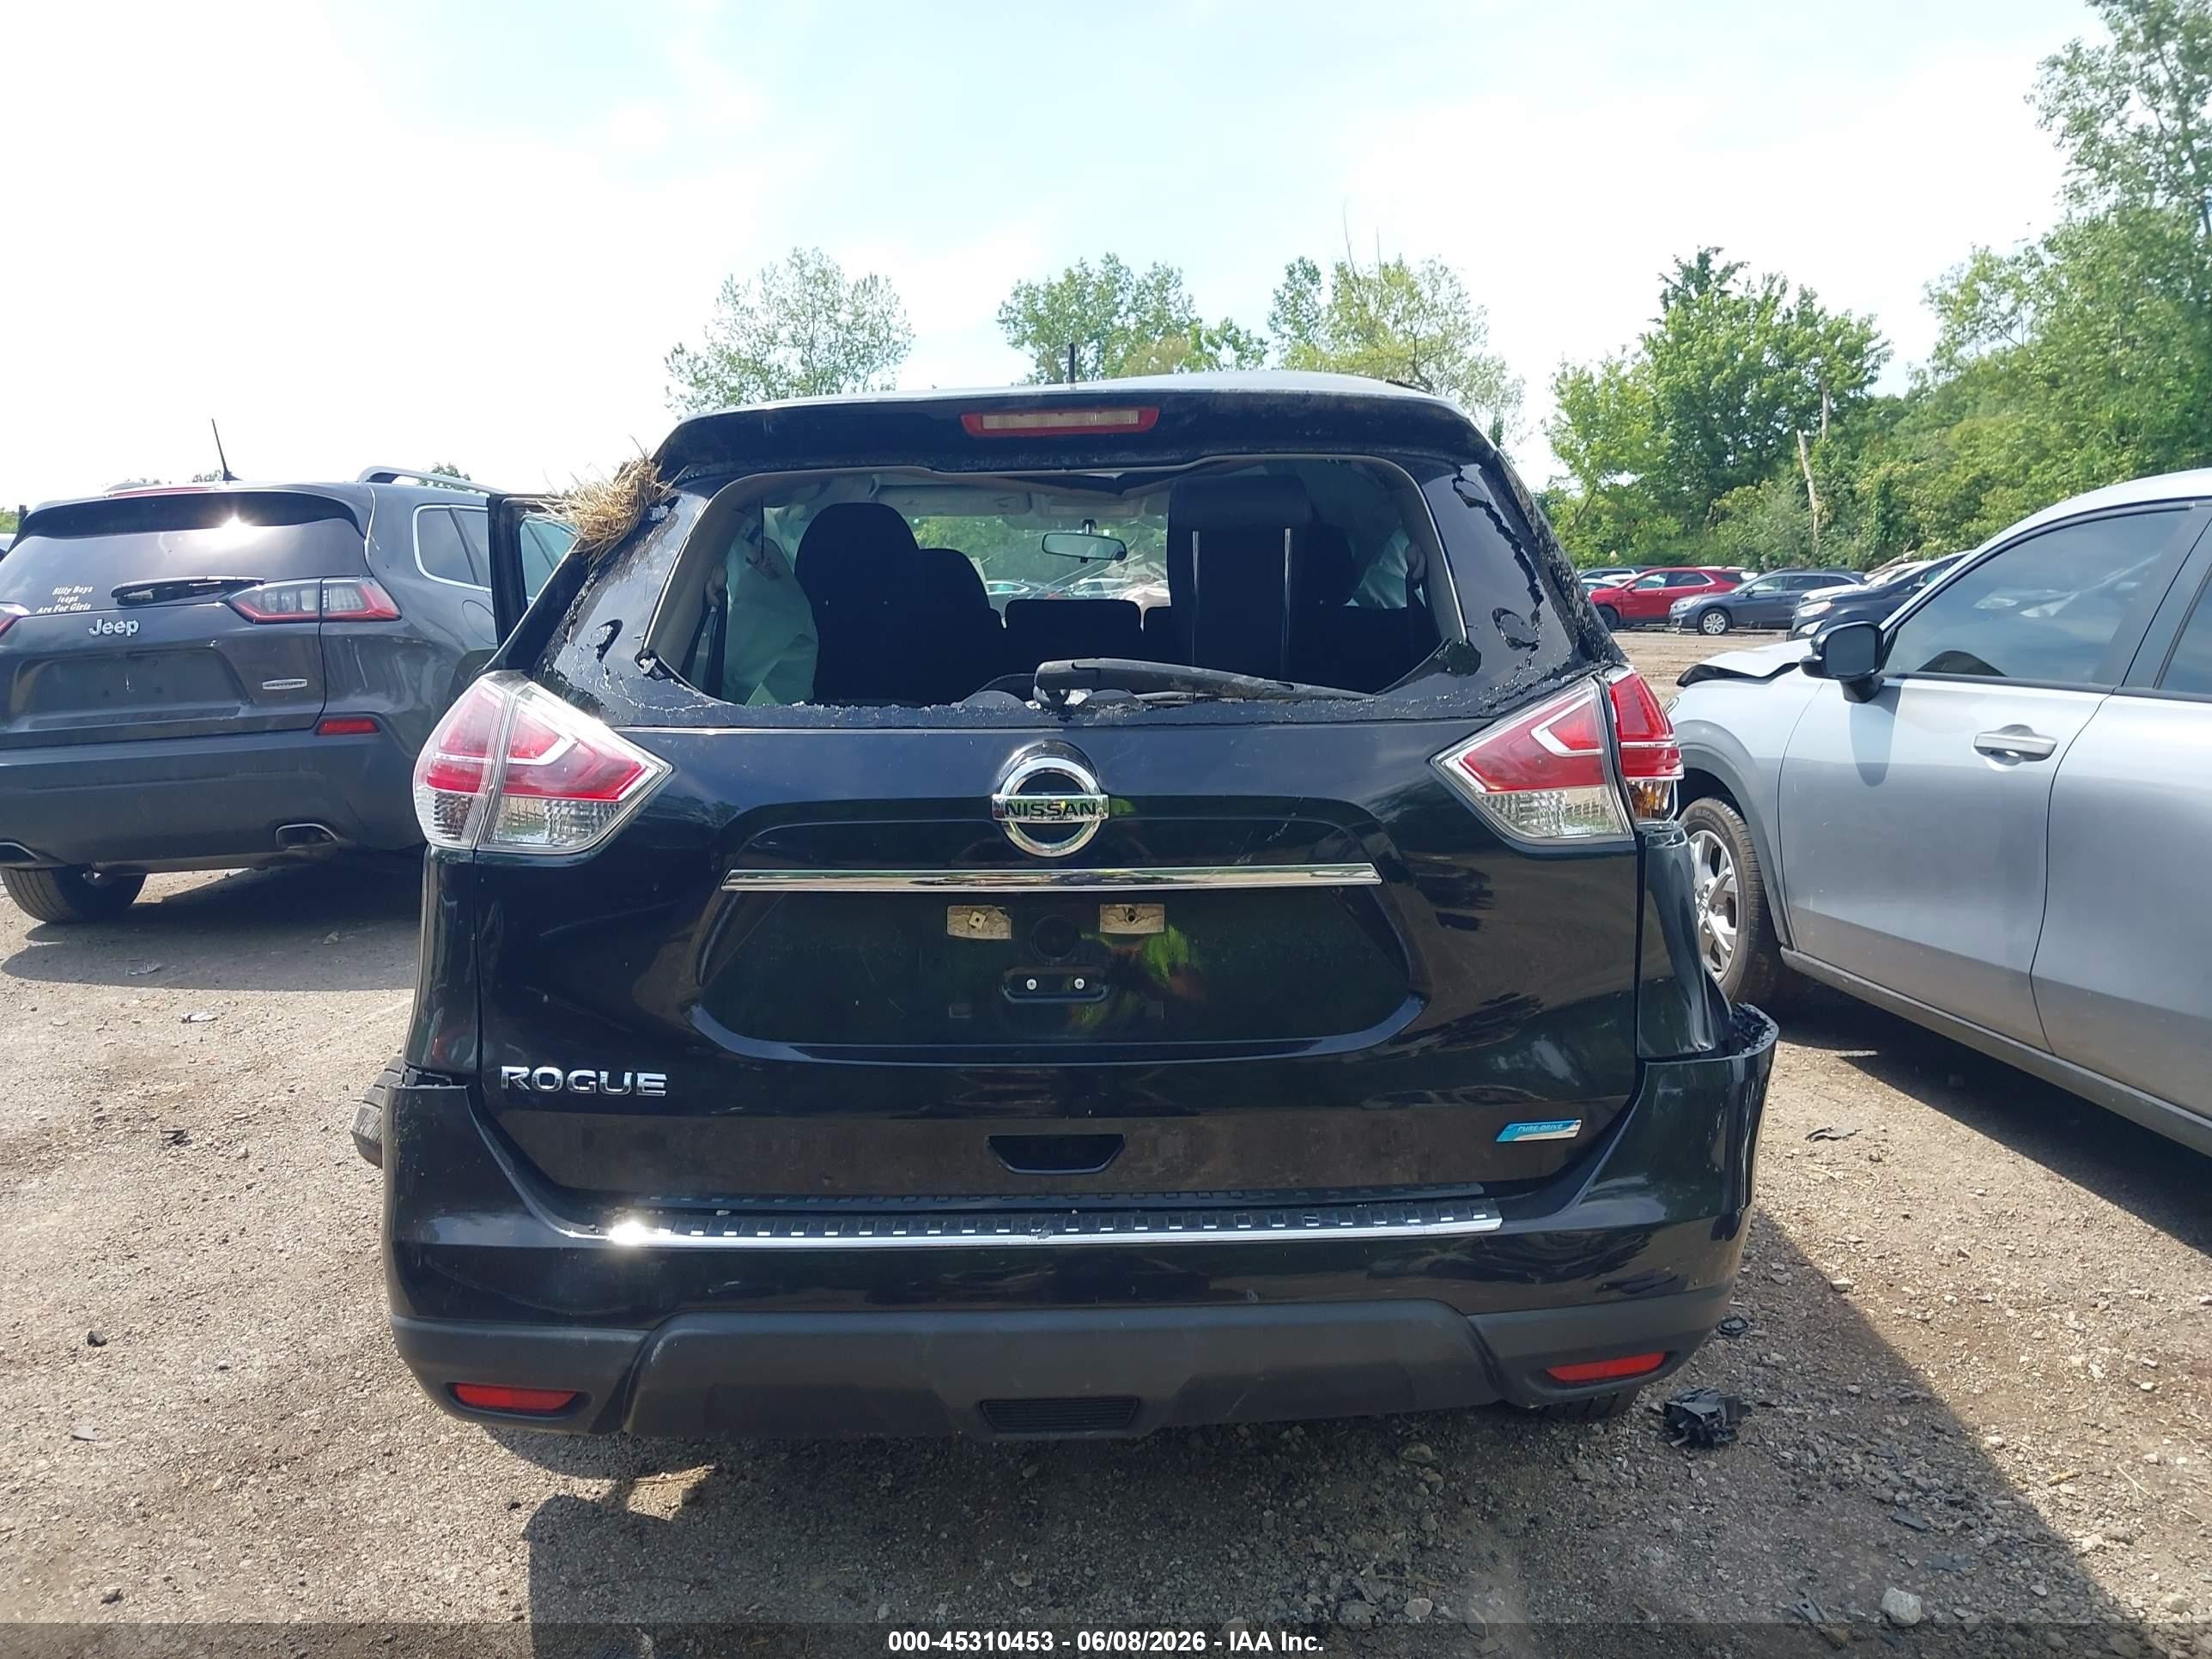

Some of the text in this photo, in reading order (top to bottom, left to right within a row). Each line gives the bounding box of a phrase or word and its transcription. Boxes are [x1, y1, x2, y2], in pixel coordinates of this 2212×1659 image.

[52, 586, 94, 596] Silly Boys
[53, 604, 70, 612] For
[88, 618, 139, 636] Jeep
[1005, 802, 1097, 817] NISSAN
[501, 1066, 667, 1097] ROGUE
